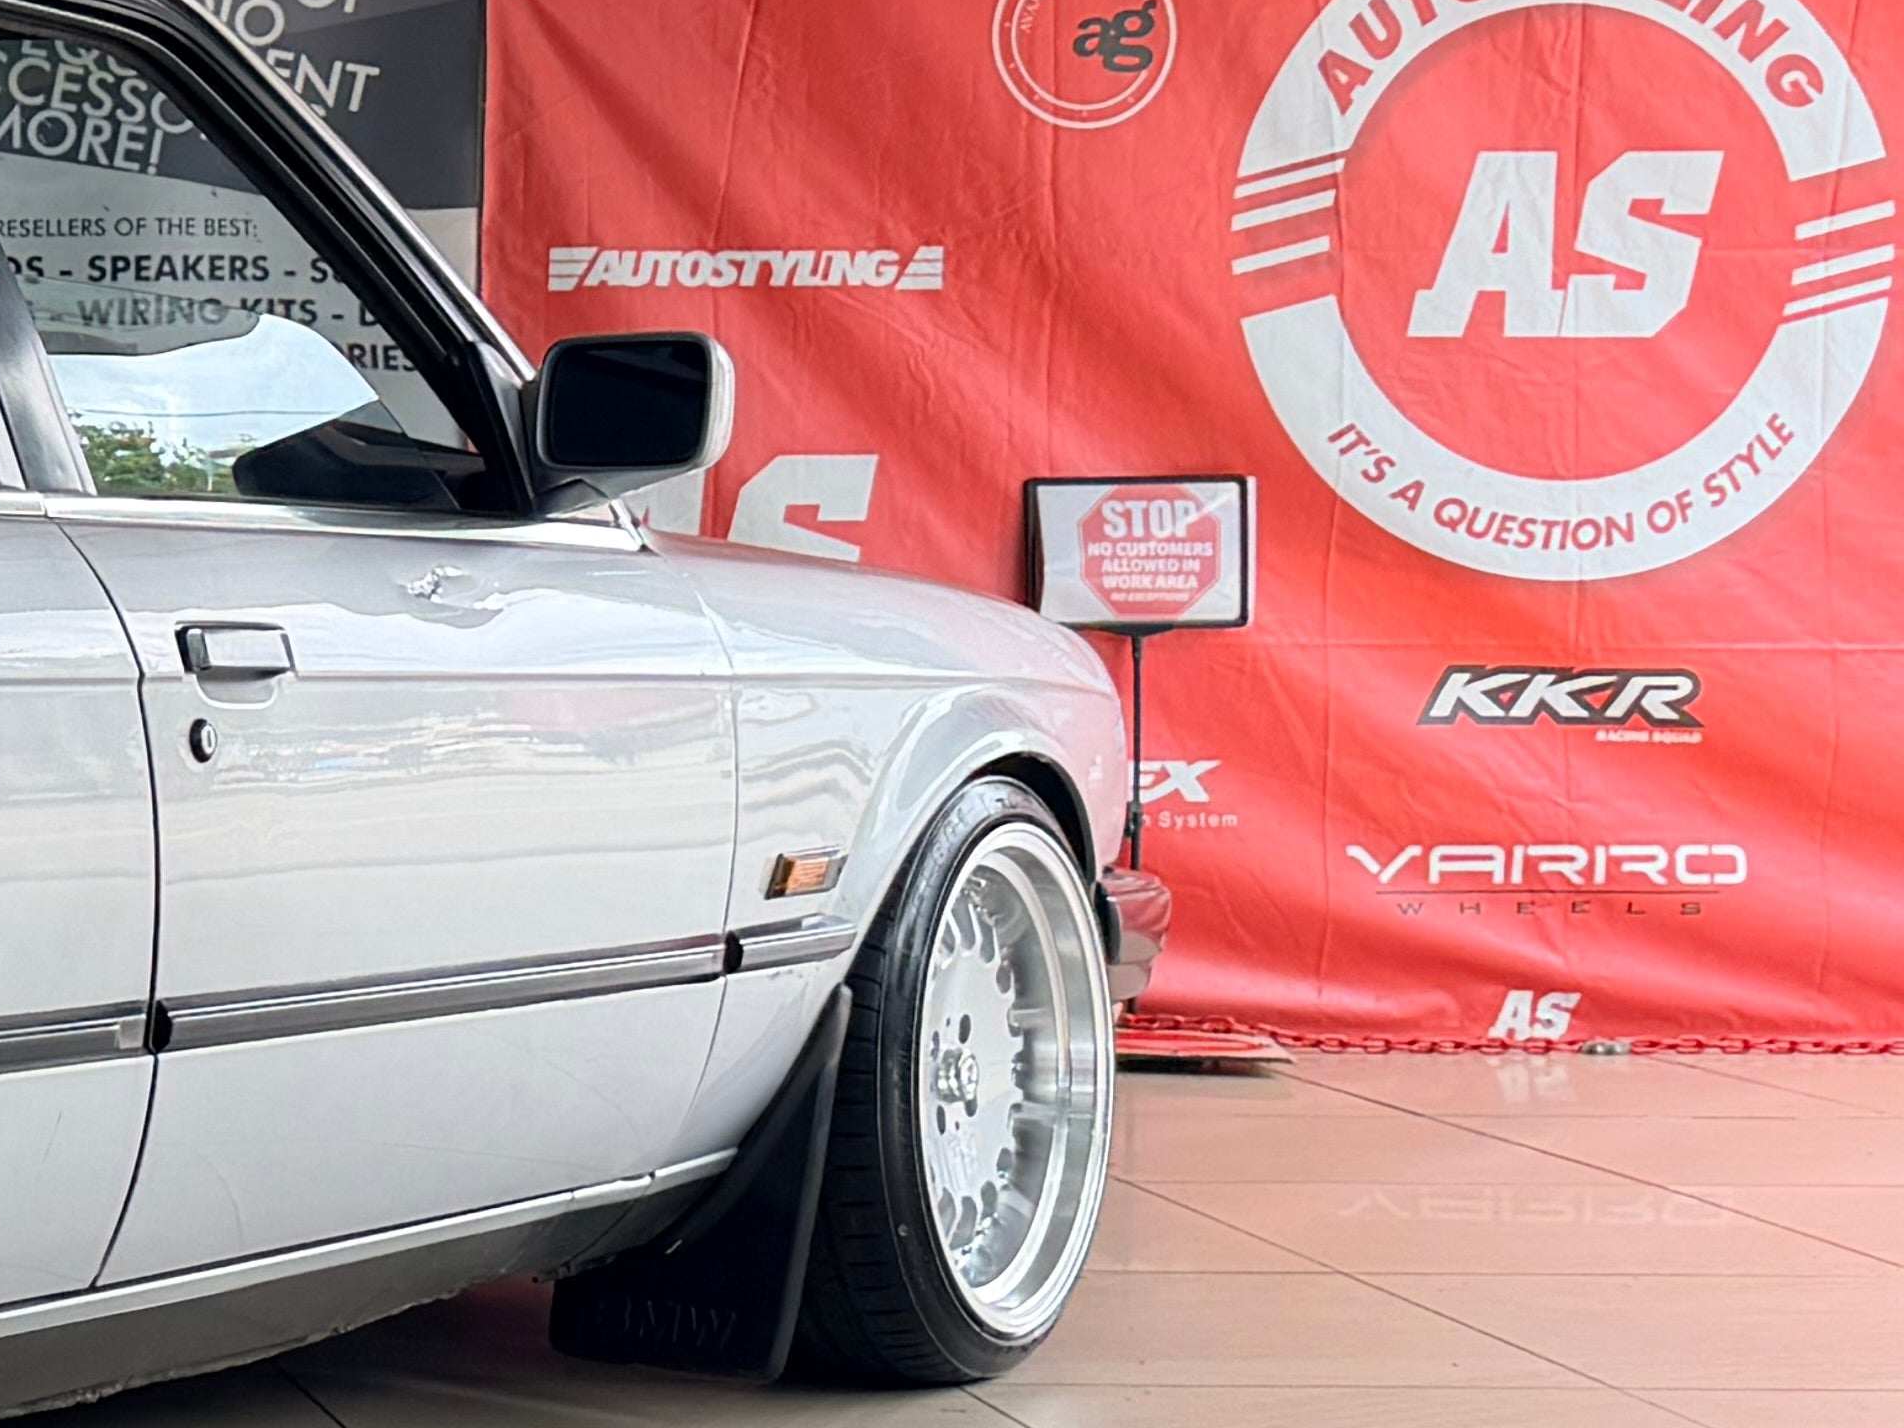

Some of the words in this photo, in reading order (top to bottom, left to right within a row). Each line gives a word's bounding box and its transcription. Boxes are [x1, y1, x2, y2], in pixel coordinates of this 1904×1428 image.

[115, 218, 146, 235] OF
[155, 218, 194, 234] THE
[205, 218, 257, 237] BEST:
[1407, 150, 1725, 339] AS
[88, 254, 269, 281] SPEAKERS
[588, 249, 900, 288] AUTOSTYLING
[78, 298, 223, 326] WIRING
[1329, 423, 1395, 485] IT'S
[1390, 479, 1424, 510] A
[1434, 497, 1635, 550] QUESTION
[1646, 492, 1694, 535] OF
[1704, 413, 1794, 508] STYLE
[1102, 500, 1197, 539] STOP
[1088, 542, 1113, 556] NO
[1115, 542, 1213, 556] CUSTOMERS
[1101, 559, 1179, 573] ALLOWED
[1182, 559, 1200, 573] IN
[1101, 575, 1152, 589] WORK
[1155, 575, 1198, 589] AREA
[1426, 668, 1697, 723] KKR
[1158, 811, 1238, 831] System
[1345, 843, 1748, 886] VARRO
[1398, 902, 1701, 915] WHEELS
[1489, 989, 1582, 1039] AS
